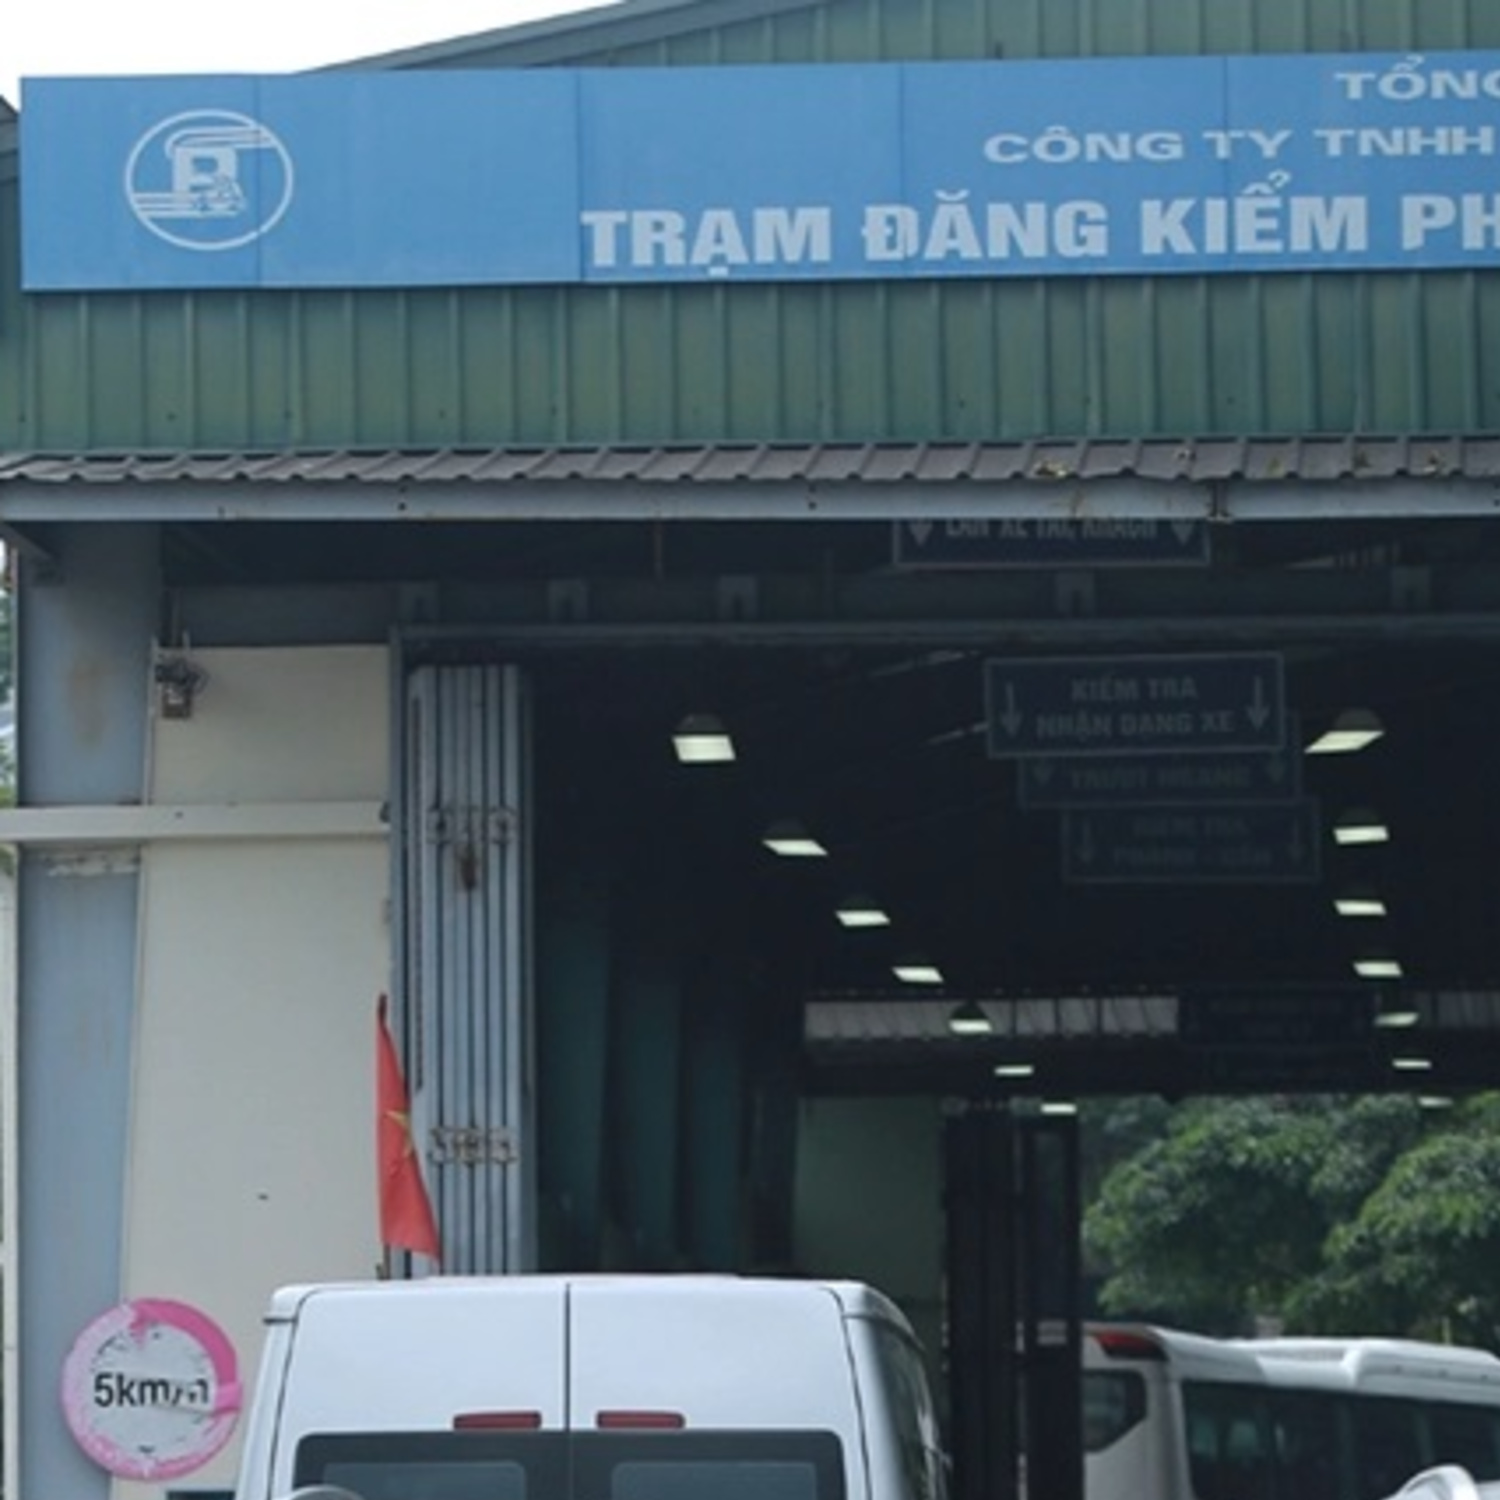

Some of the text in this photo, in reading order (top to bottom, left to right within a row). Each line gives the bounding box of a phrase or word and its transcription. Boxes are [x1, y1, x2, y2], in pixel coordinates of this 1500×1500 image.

[984, 126, 1184, 162] CÔNG
[1203, 130, 1293, 159] TY
[1313, 127, 1495, 157] TNHH
[581, 209, 831, 276] TRẠM
[862, 190, 1108, 262] ĐĂNG
[1140, 170, 1368, 256] KIỂM
